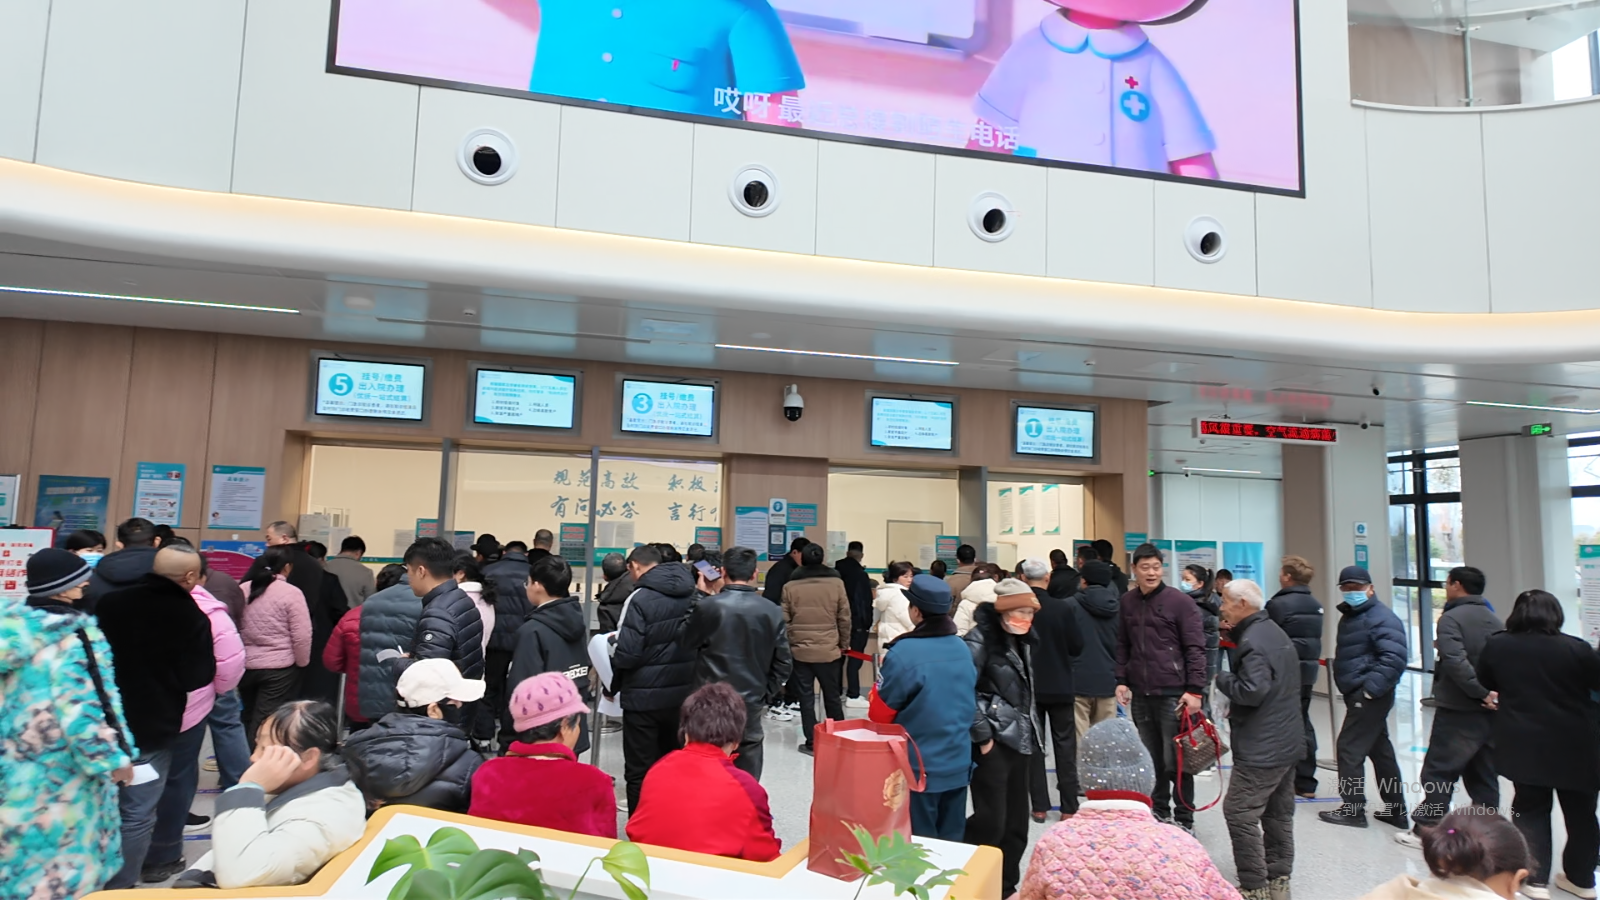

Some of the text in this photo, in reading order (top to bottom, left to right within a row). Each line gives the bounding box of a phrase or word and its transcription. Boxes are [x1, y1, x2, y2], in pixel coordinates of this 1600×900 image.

[713, 86, 771, 116] 哎呀
[358, 382, 405, 393] 出入院办理
[553, 469, 718, 493] 规范高效 积极
[550, 495, 640, 519] 有问必答
